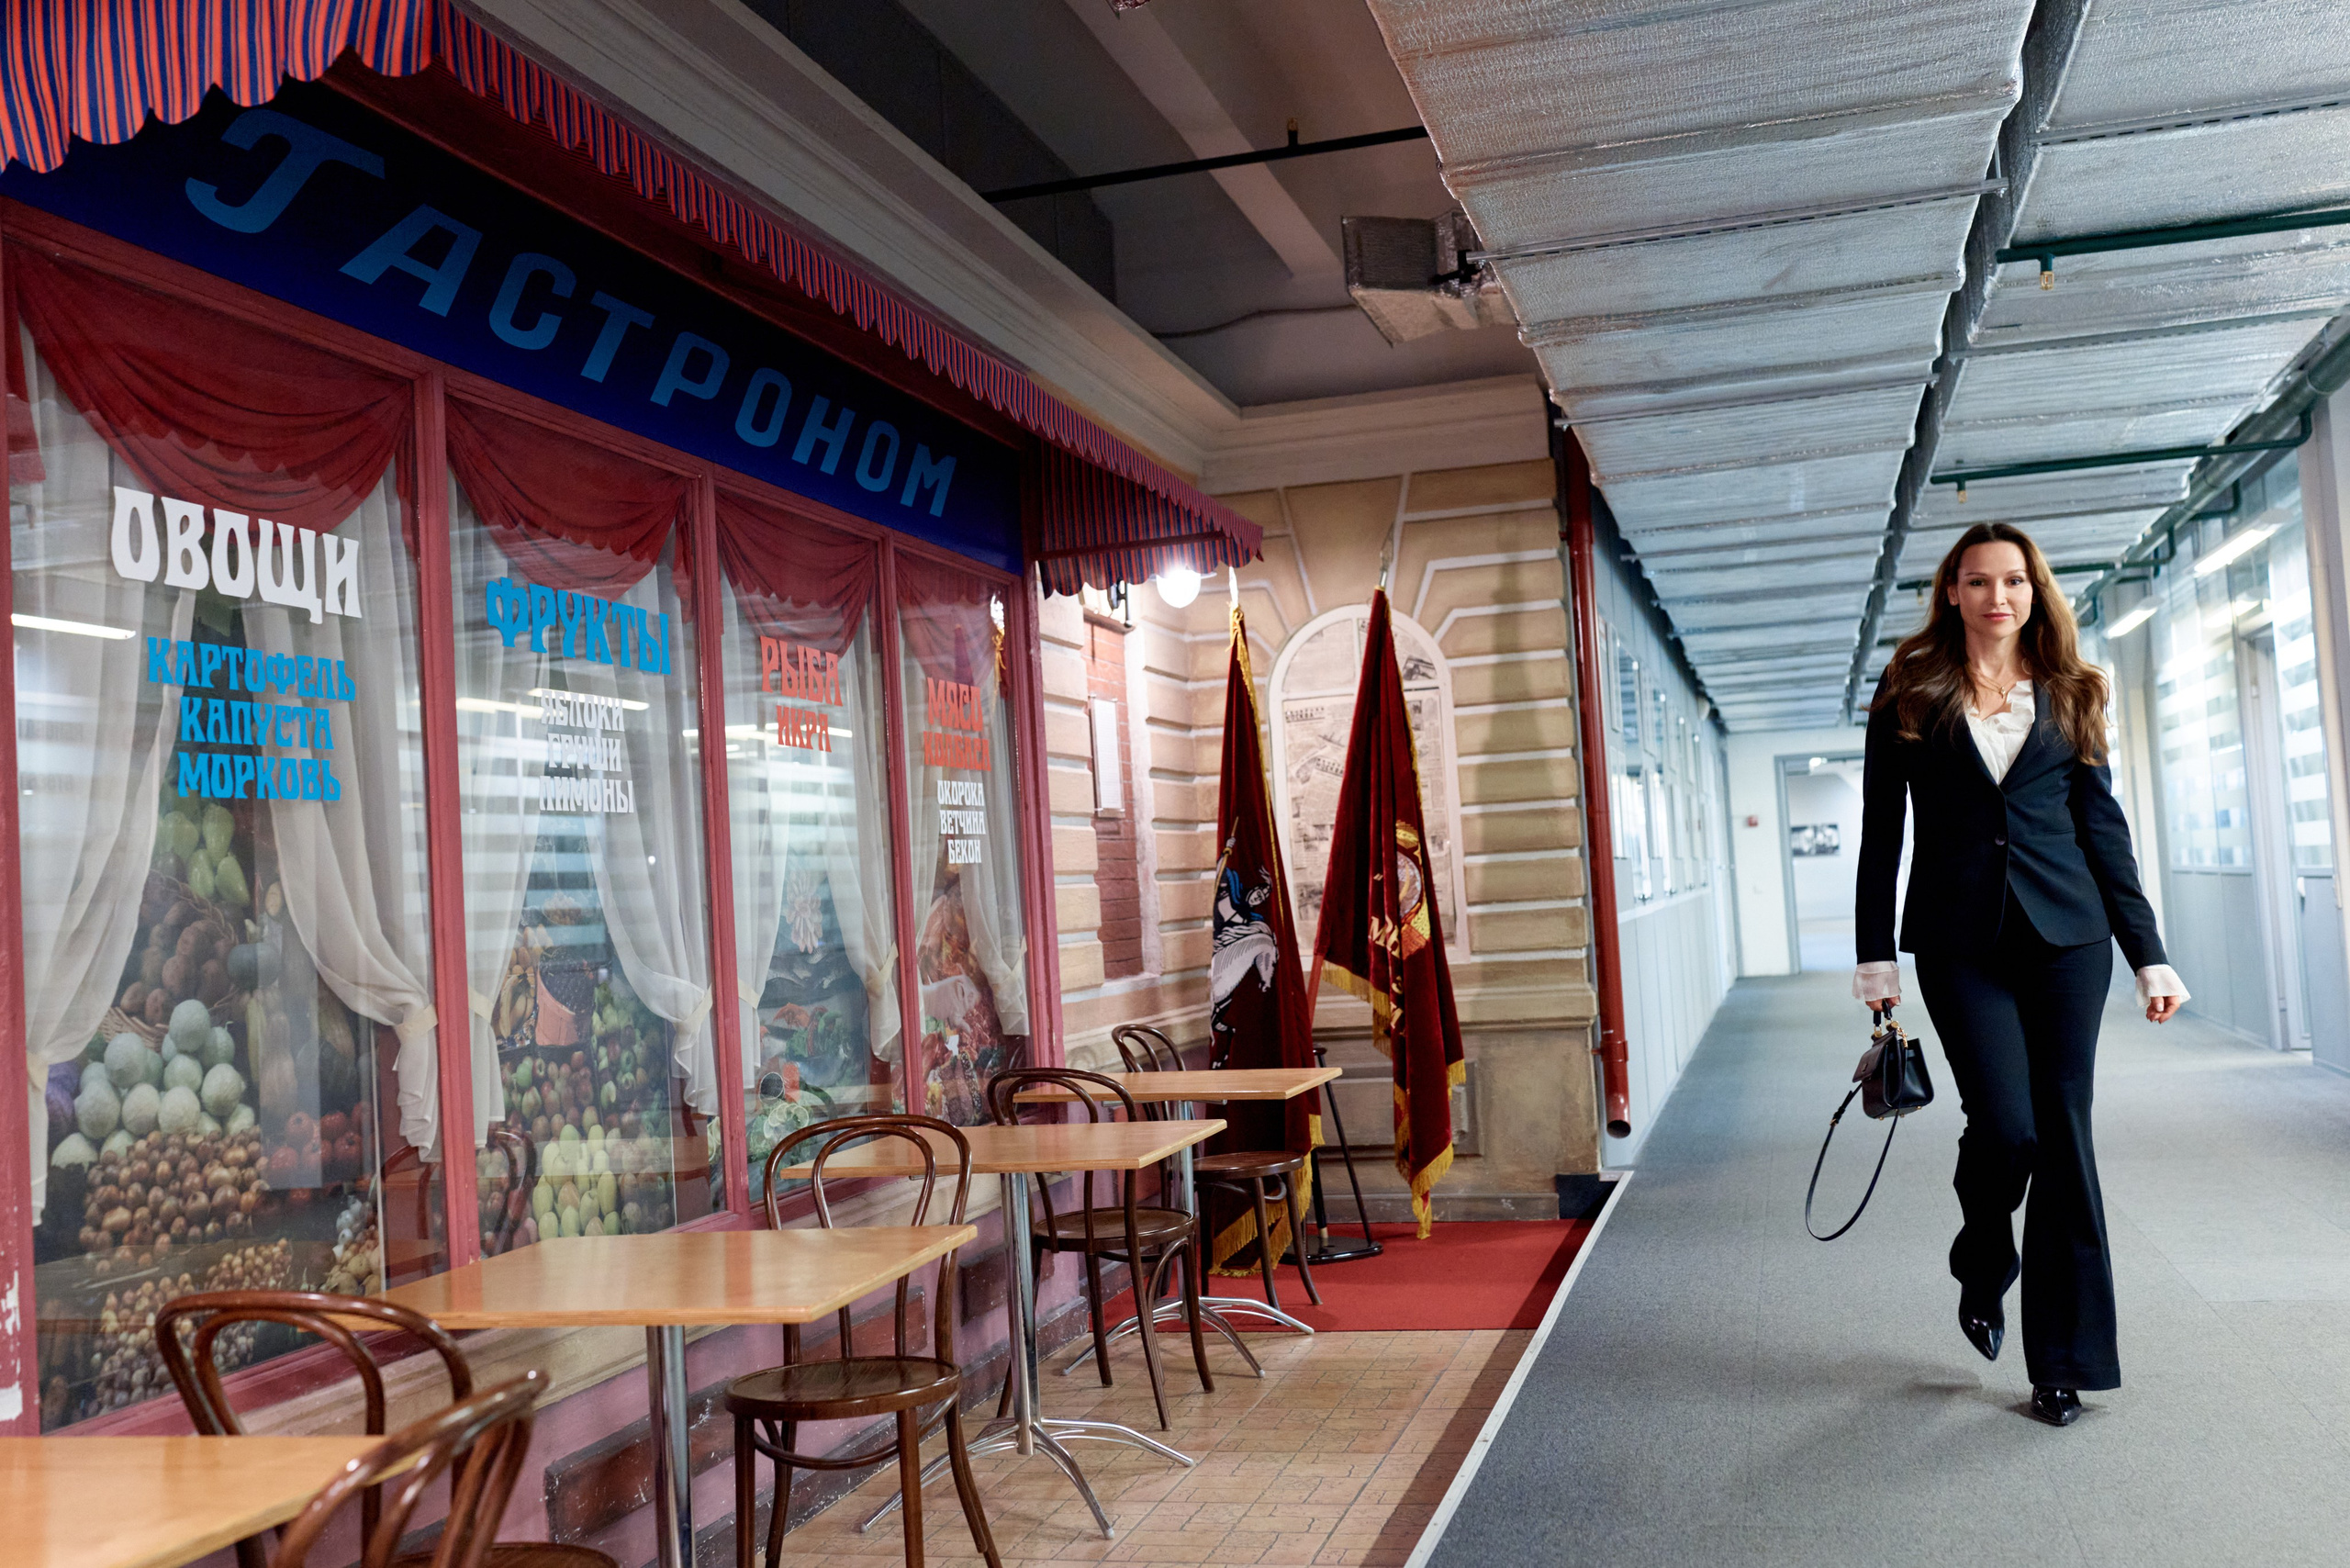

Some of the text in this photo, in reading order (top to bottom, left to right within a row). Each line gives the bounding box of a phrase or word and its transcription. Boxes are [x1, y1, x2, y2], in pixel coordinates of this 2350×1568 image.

[111, 486, 363, 624] ОВОЩИ
[486, 577, 671, 675] ФРУКТЫ
[146, 636, 356, 701] КАРТОФЕЛЬ
[760, 635, 843, 707] РЫБА
[180, 696, 334, 750] КАПУСТА
[540, 689, 625, 732] ЯБЛОКИ
[927, 677, 983, 732] МЯСО
[548, 734, 622, 771] ГРУШИ
[776, 705, 832, 753] ИКРА
[923, 731, 991, 772] КОЛБАСА
[178, 752, 341, 801] МОРКОВЬ
[539, 776, 634, 813] ЛИМОНЫ
[937, 780, 985, 806] ОКОРОКА
[939, 810, 986, 834] ВЕТЧИНА
[947, 839, 982, 864] БЕКОН
